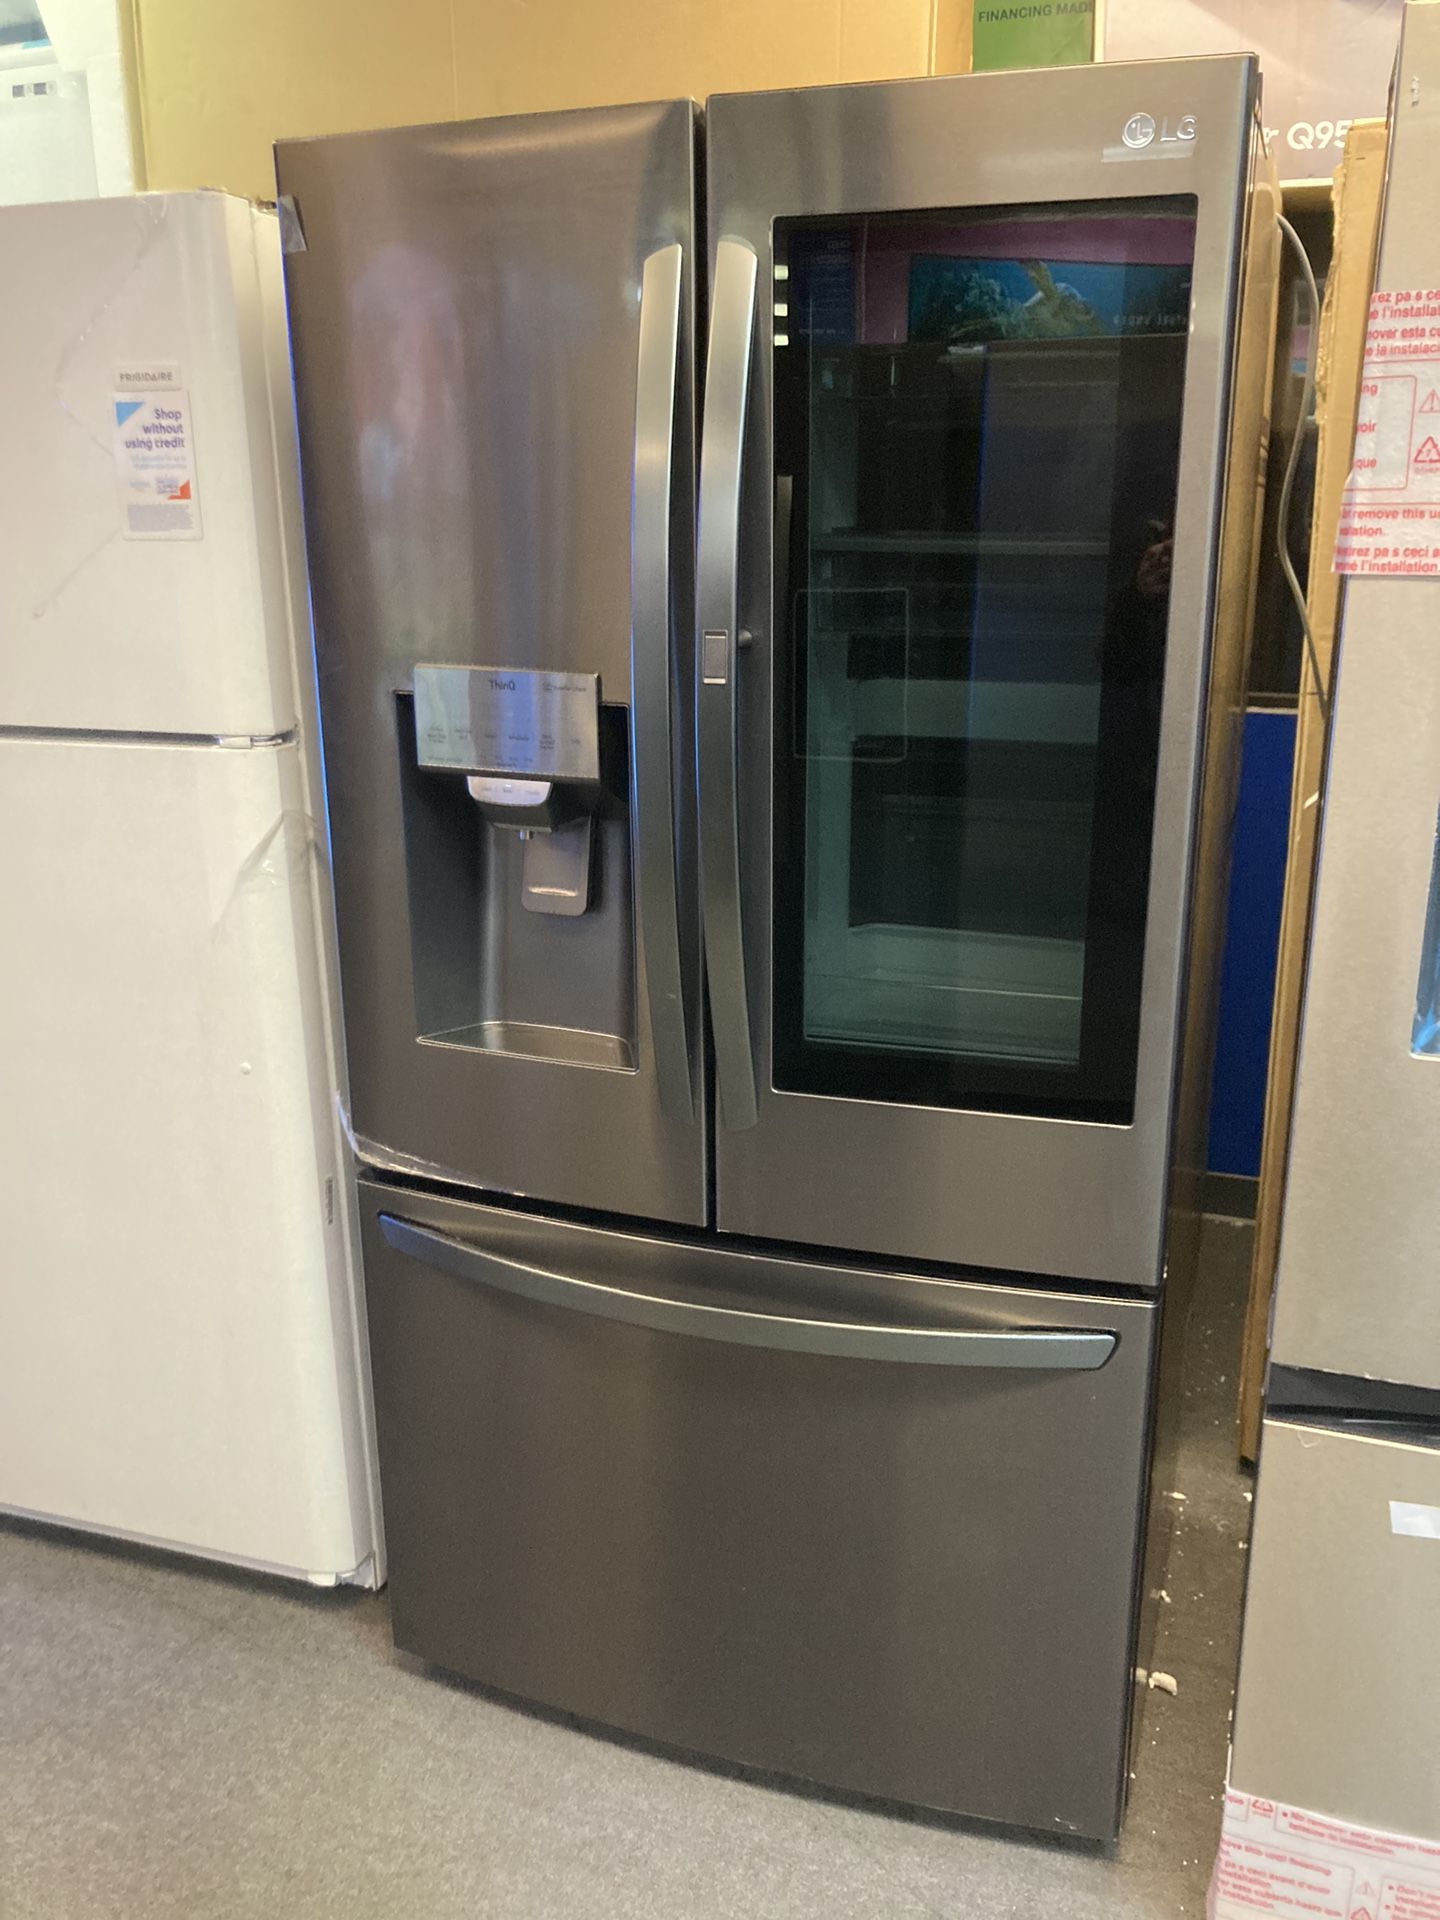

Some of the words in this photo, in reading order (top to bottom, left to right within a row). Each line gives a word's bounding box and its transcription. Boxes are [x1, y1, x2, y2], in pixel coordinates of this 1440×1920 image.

[978, 4, 1052, 23] FINANCING
[1160, 115, 1197, 142] LG
[1401, 326, 1426, 338] esta
[119, 371, 174, 382] FRIGIDAIRE
[154, 408, 182, 421] Shop
[143, 423, 184, 434] without
[125, 438, 153, 451] using
[155, 437, 185, 448] credit
[1402, 508, 1425, 519] this
[488, 679, 516, 692] ThinQ
